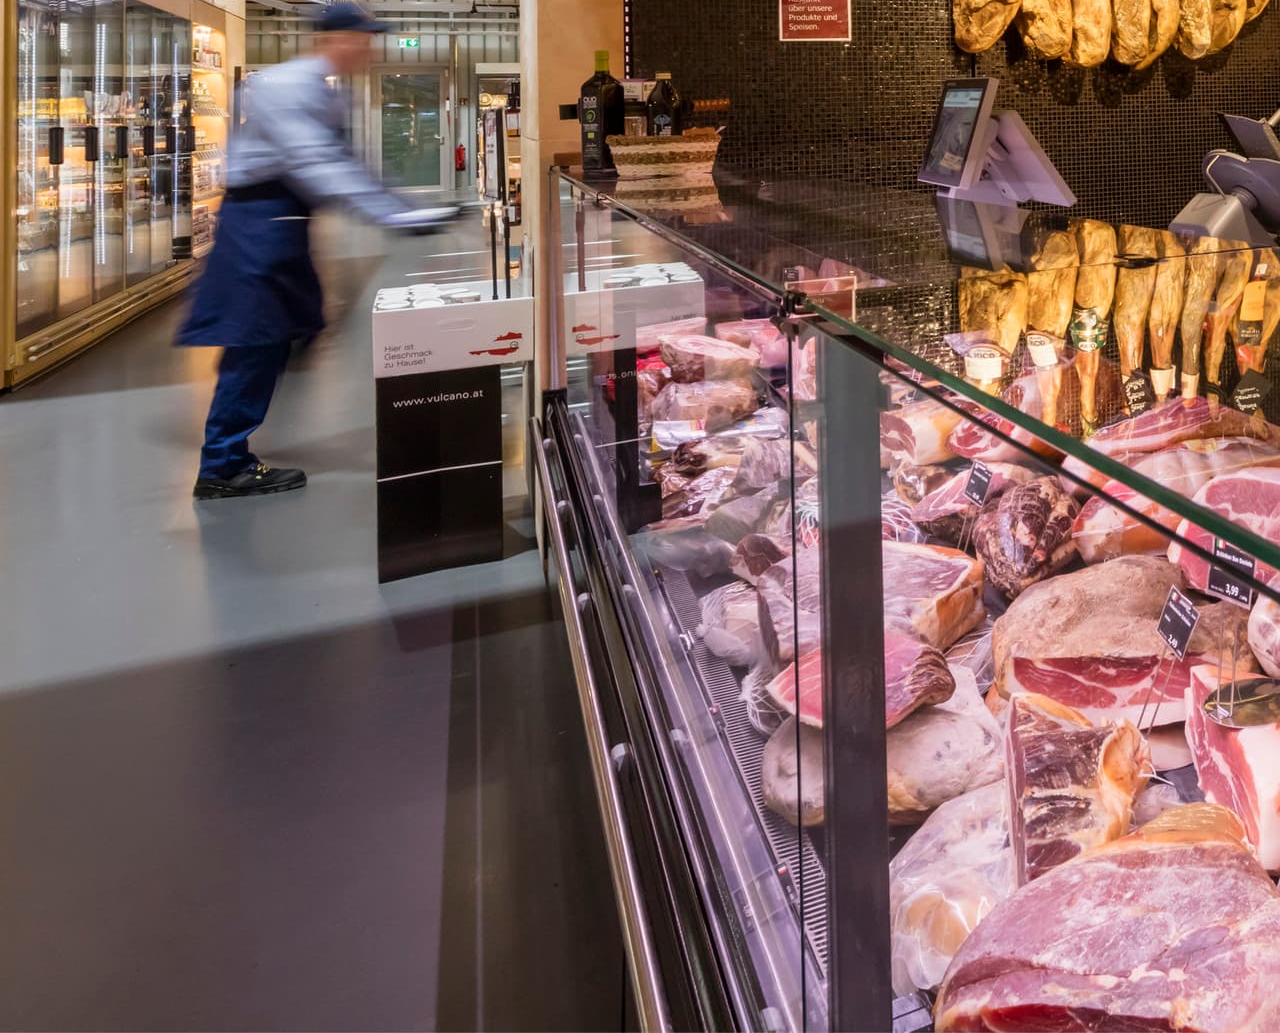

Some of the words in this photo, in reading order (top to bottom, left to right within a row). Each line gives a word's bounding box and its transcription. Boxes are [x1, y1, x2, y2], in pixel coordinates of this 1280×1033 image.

[788, 13, 822, 21] Produkte
[823, 13, 838, 21] und
[788, 23, 820, 31] Speisen.
[384, 345, 401, 353] Hier
[384, 349, 433, 361] Geschmack
[397, 358, 426, 367] Hause!
[392, 389, 484, 408] www.vulcano.at
[1225, 583, 1240, 596] 3,99
